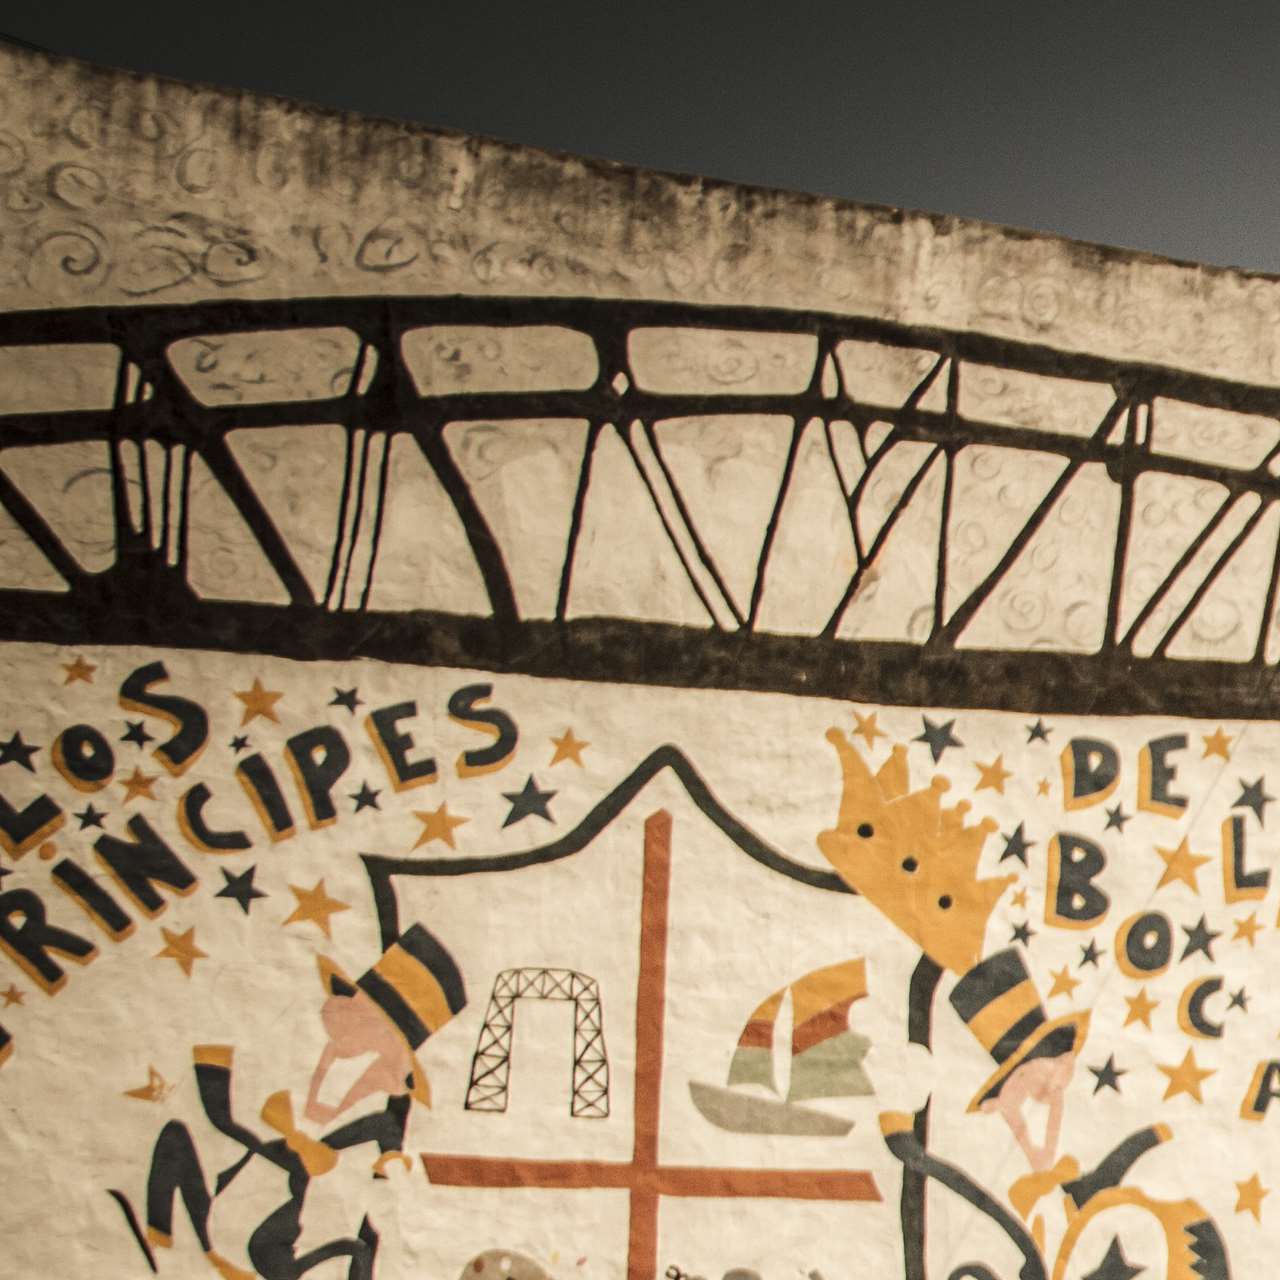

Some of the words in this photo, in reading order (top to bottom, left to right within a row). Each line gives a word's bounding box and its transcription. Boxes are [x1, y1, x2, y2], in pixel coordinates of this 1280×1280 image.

[0, 660, 210, 861] LOS
[1059, 732, 1189, 819] DE
[0, 682, 520, 1069] RINCIPES
